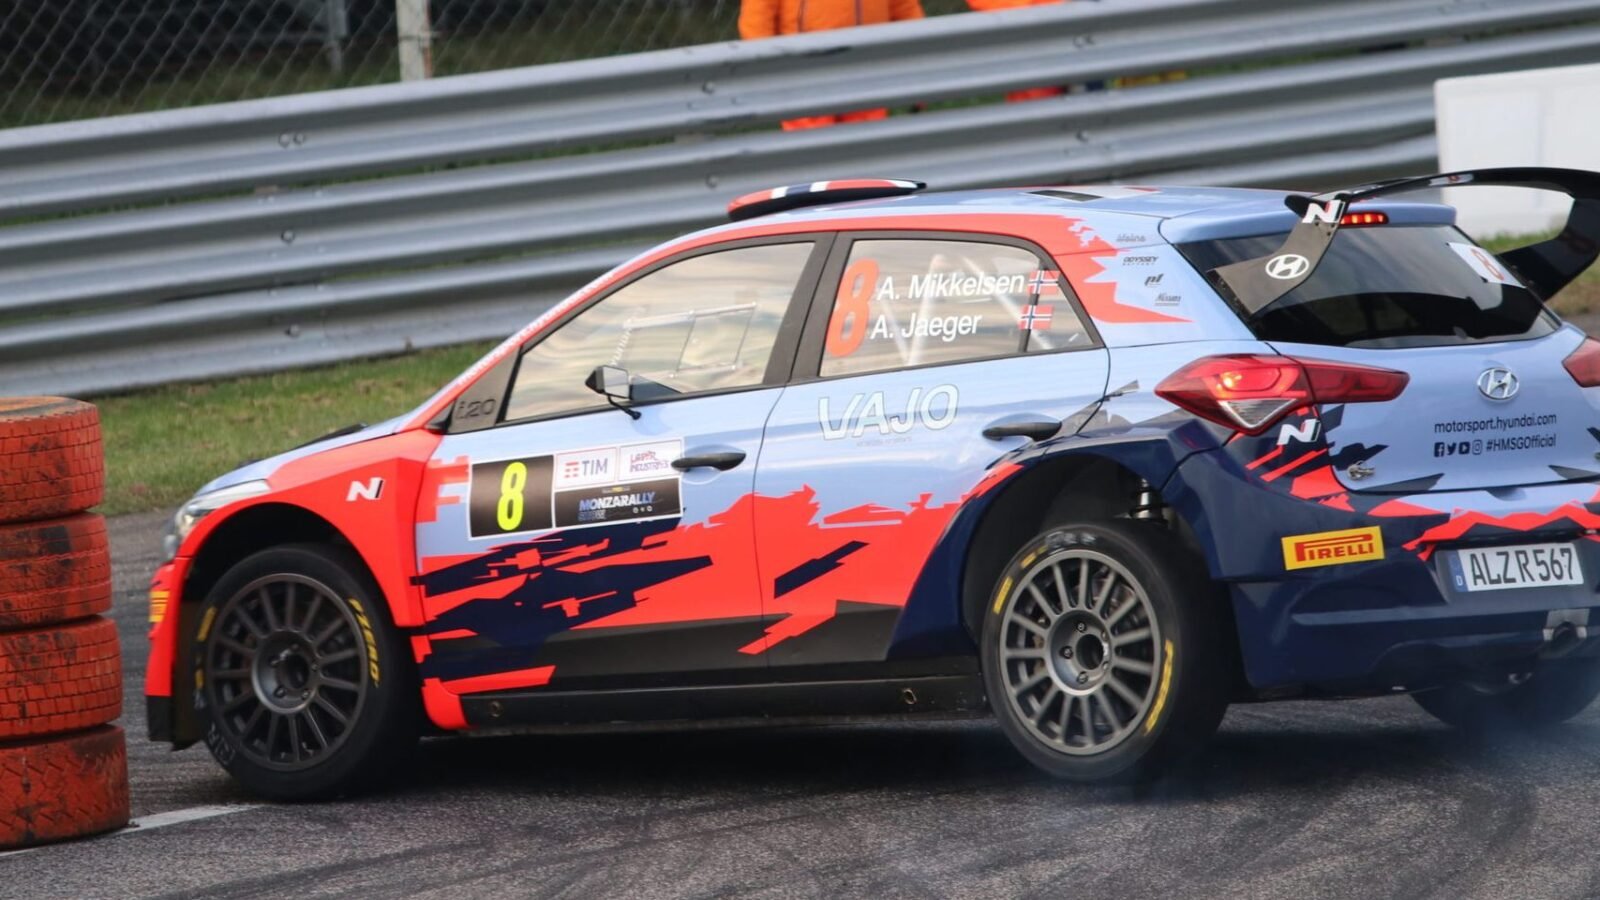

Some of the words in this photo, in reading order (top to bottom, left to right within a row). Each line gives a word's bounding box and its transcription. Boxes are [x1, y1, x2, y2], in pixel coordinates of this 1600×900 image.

[876, 276, 900, 301] A.
[908, 273, 1025, 299] Mikkelsen
[826, 257, 880, 357] 8
[870, 314, 894, 339] A.
[901, 312, 982, 342] Jaeger
[818, 383, 960, 441] VAJO
[1434, 413, 1557, 433] motorsport.hyundai.com
[1486, 434, 1556, 452] #HMSGOfficial
[581, 458, 608, 476] TIM
[496, 461, 527, 531] 8
[579, 491, 656, 511] MONZARALLY
[1295, 534, 1373, 562] PIRELLI
